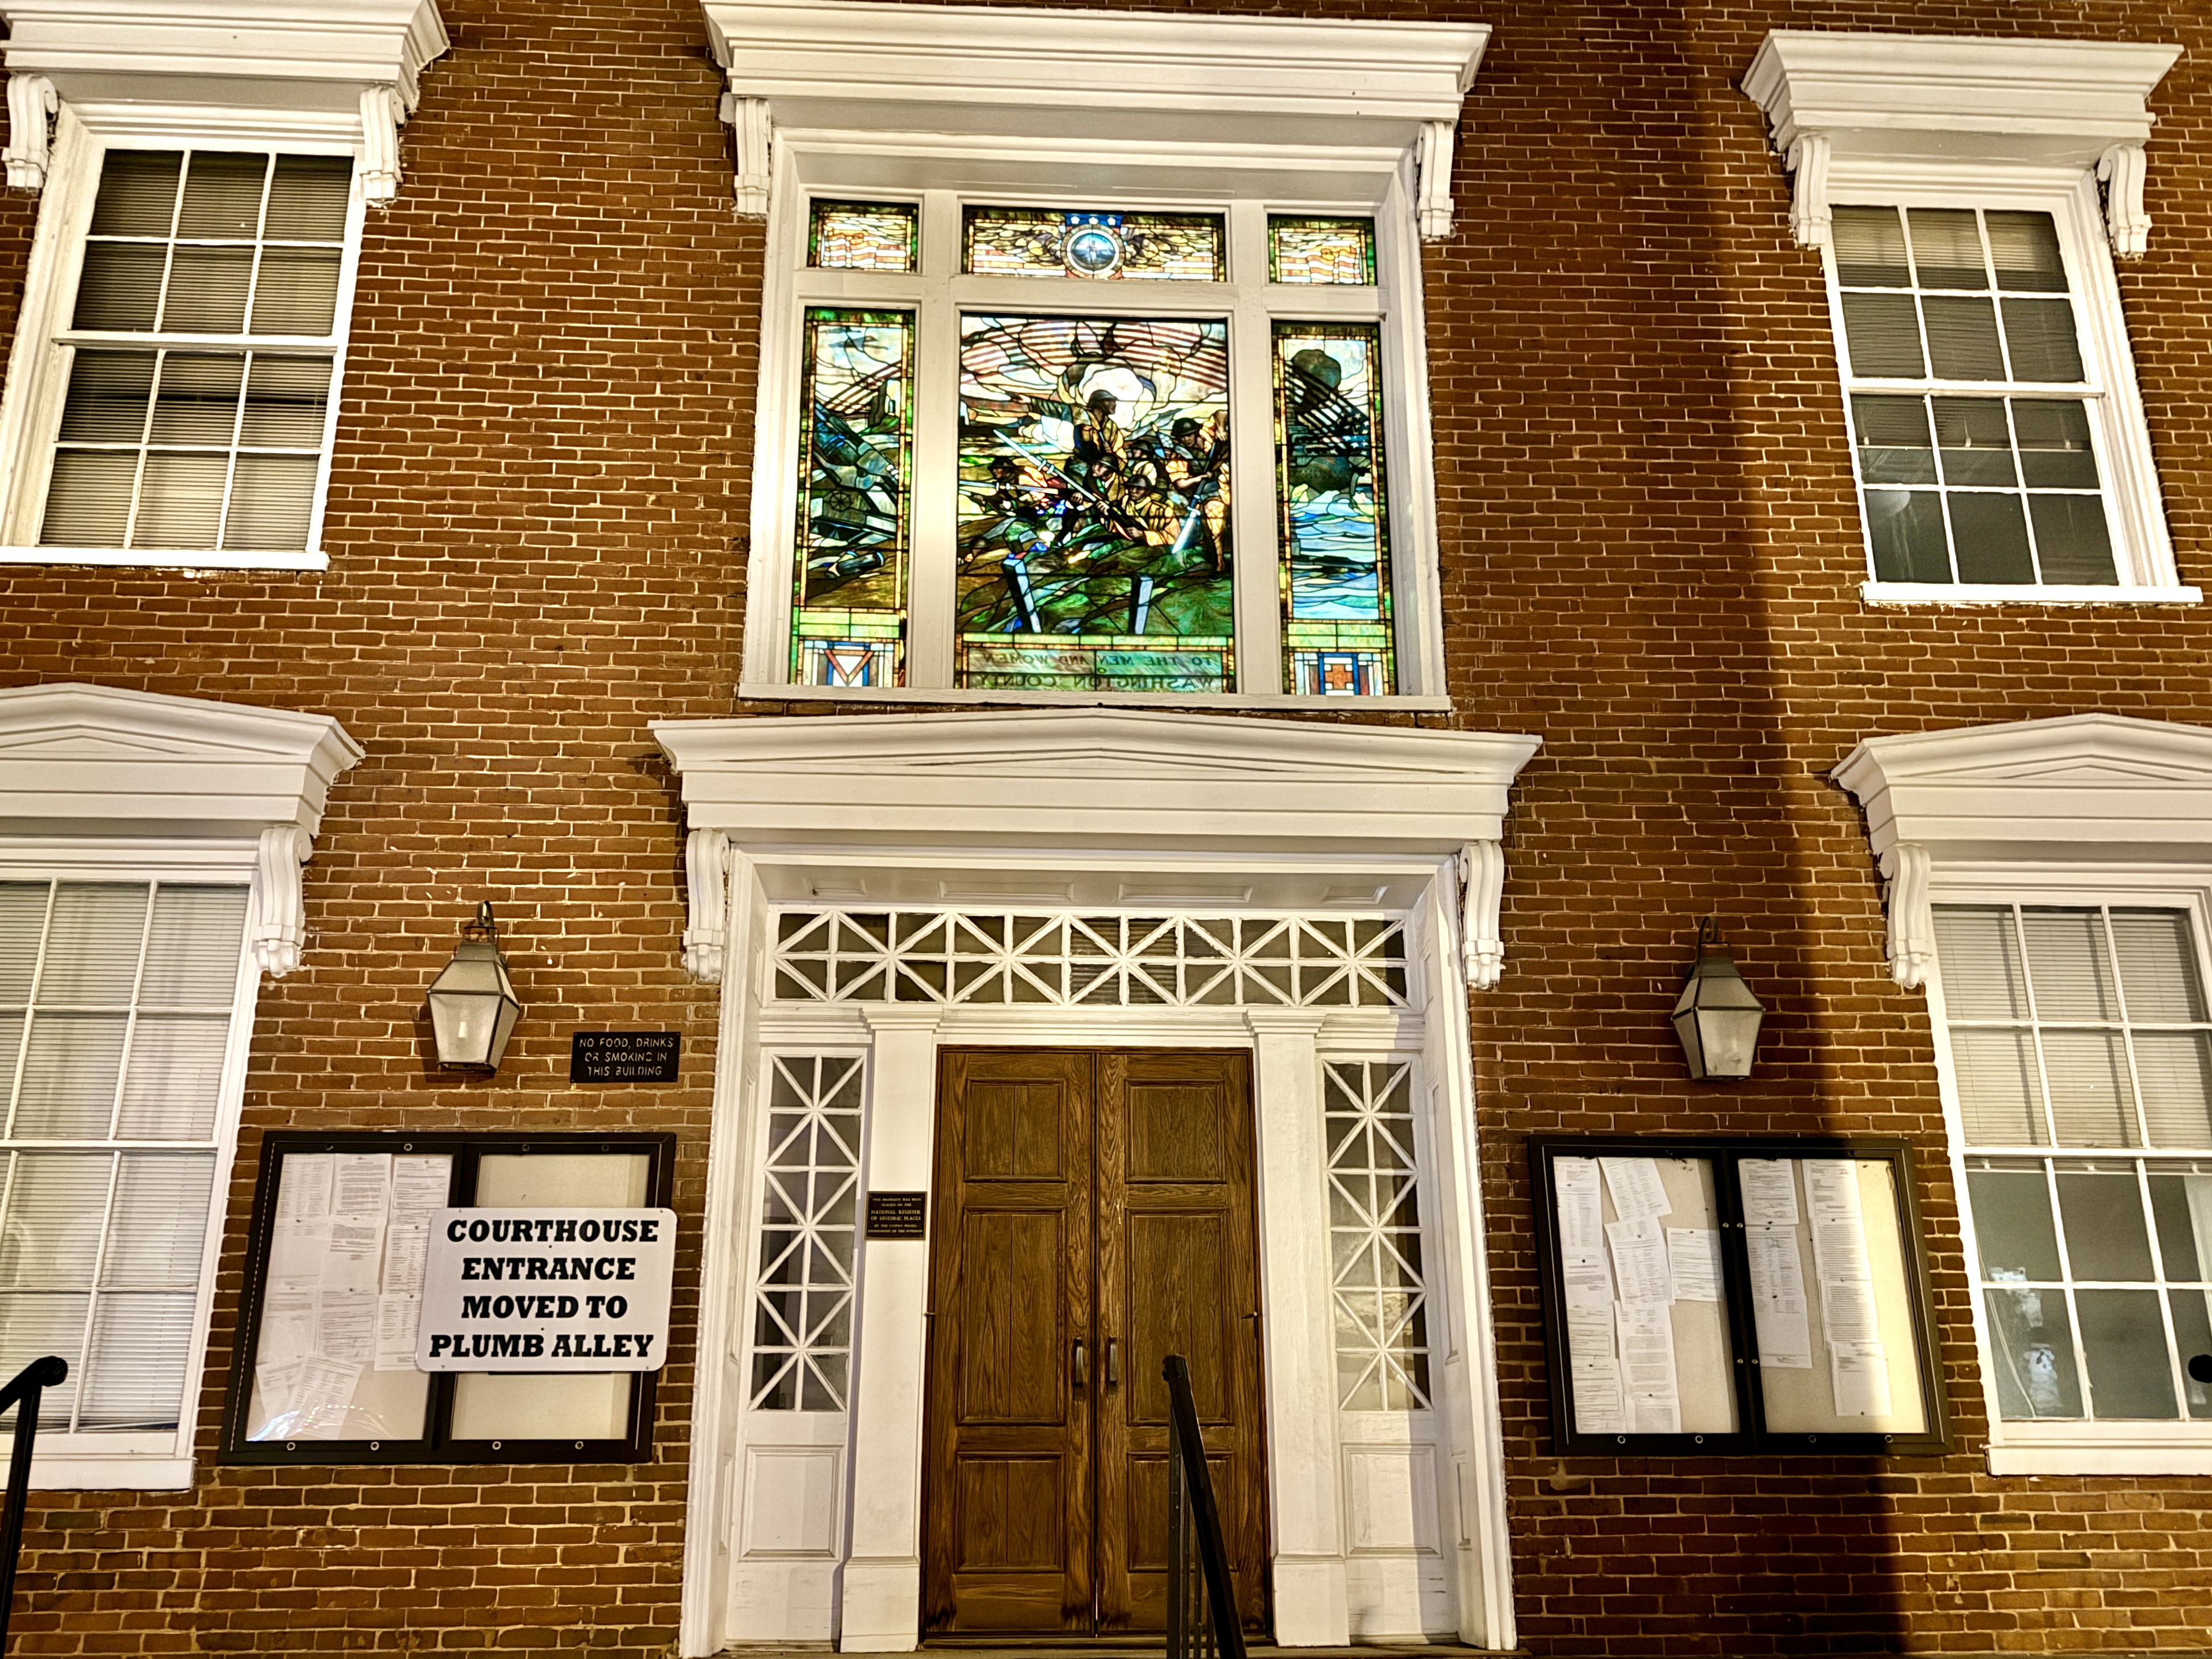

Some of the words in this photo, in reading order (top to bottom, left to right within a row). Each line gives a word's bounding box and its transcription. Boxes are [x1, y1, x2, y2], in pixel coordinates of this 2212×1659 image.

[579, 1038, 594, 1048] NO
[600, 1038, 631, 1050] FOOD,
[636, 1037, 674, 1048] DRINKS
[585, 1052, 599, 1062] OR
[604, 1052, 653, 1062] SMOKING
[657, 1052, 668, 1062] IN
[587, 1066, 610, 1077] THIS
[616, 1066, 663, 1076] BUILDING
[446, 1219, 659, 1243] COURTHOUSE
[461, 1257, 636, 1280] ENTRANCE
[461, 1295, 579, 1319] MOVED
[585, 1295, 628, 1319] TO
[429, 1334, 544, 1357] PLUMB
[551, 1334, 654, 1357] ALLEY
